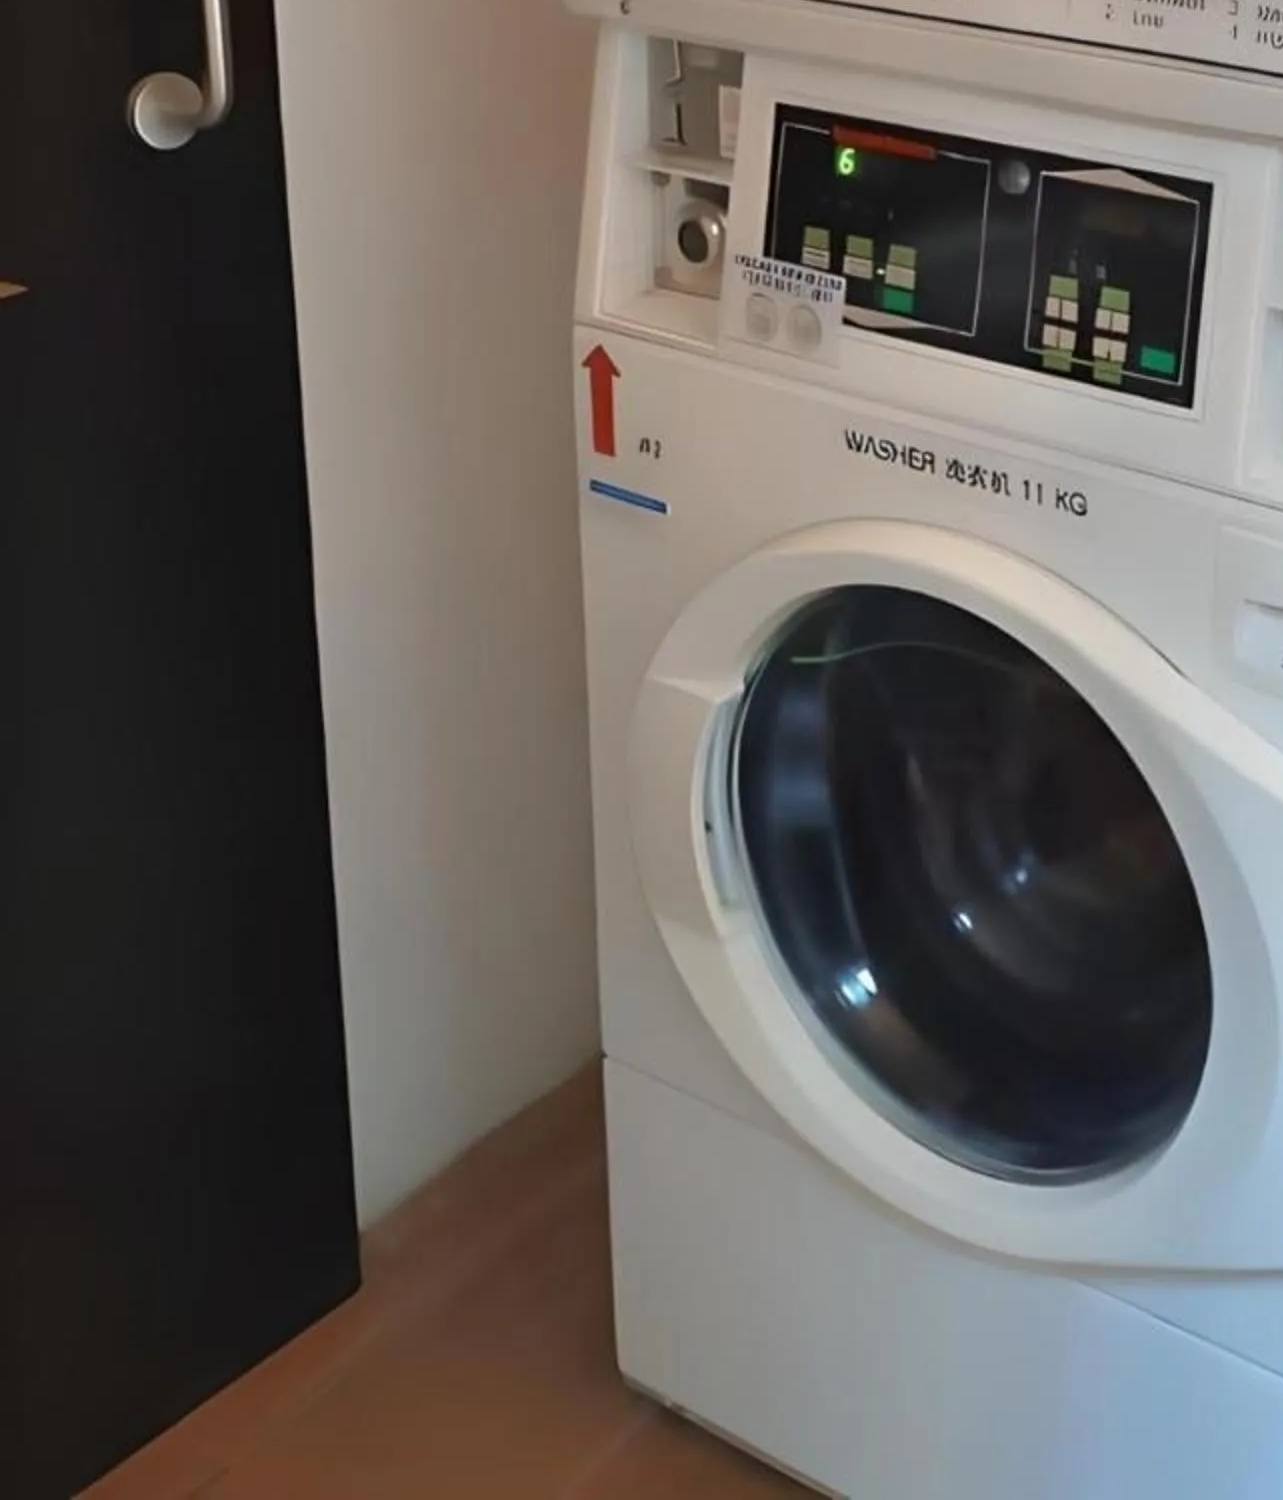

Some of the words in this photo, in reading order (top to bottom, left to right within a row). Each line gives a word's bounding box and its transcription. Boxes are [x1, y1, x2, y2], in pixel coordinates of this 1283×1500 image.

[838, 147, 856, 175] 6
[844, 429, 936, 475] WASHER
[1055, 486, 1089, 517] KG
